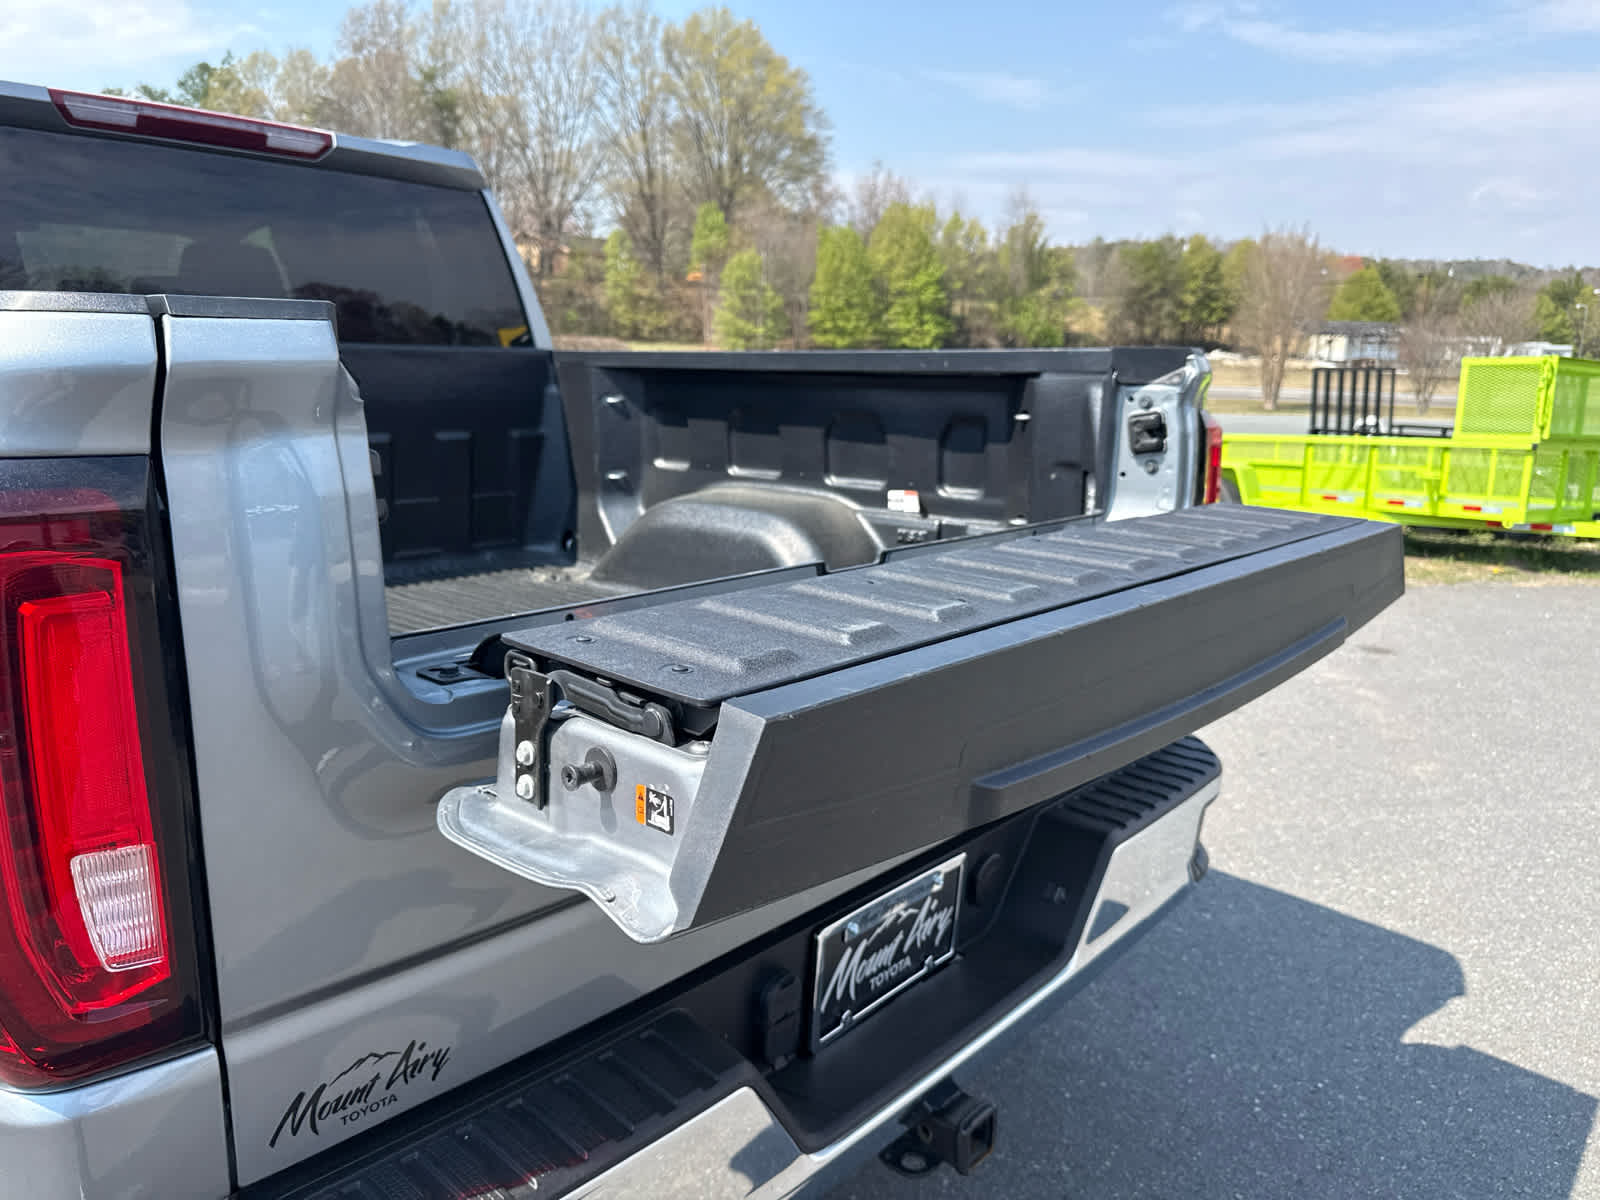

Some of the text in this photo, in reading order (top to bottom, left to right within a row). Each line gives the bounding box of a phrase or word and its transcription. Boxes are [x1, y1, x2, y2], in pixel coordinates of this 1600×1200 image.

[820, 896, 954, 1013] Mount Airy
[870, 955, 912, 991] TOYOTA
[268, 1039, 450, 1148] Mount Airy
[340, 1093, 398, 1126] TOYOTA
